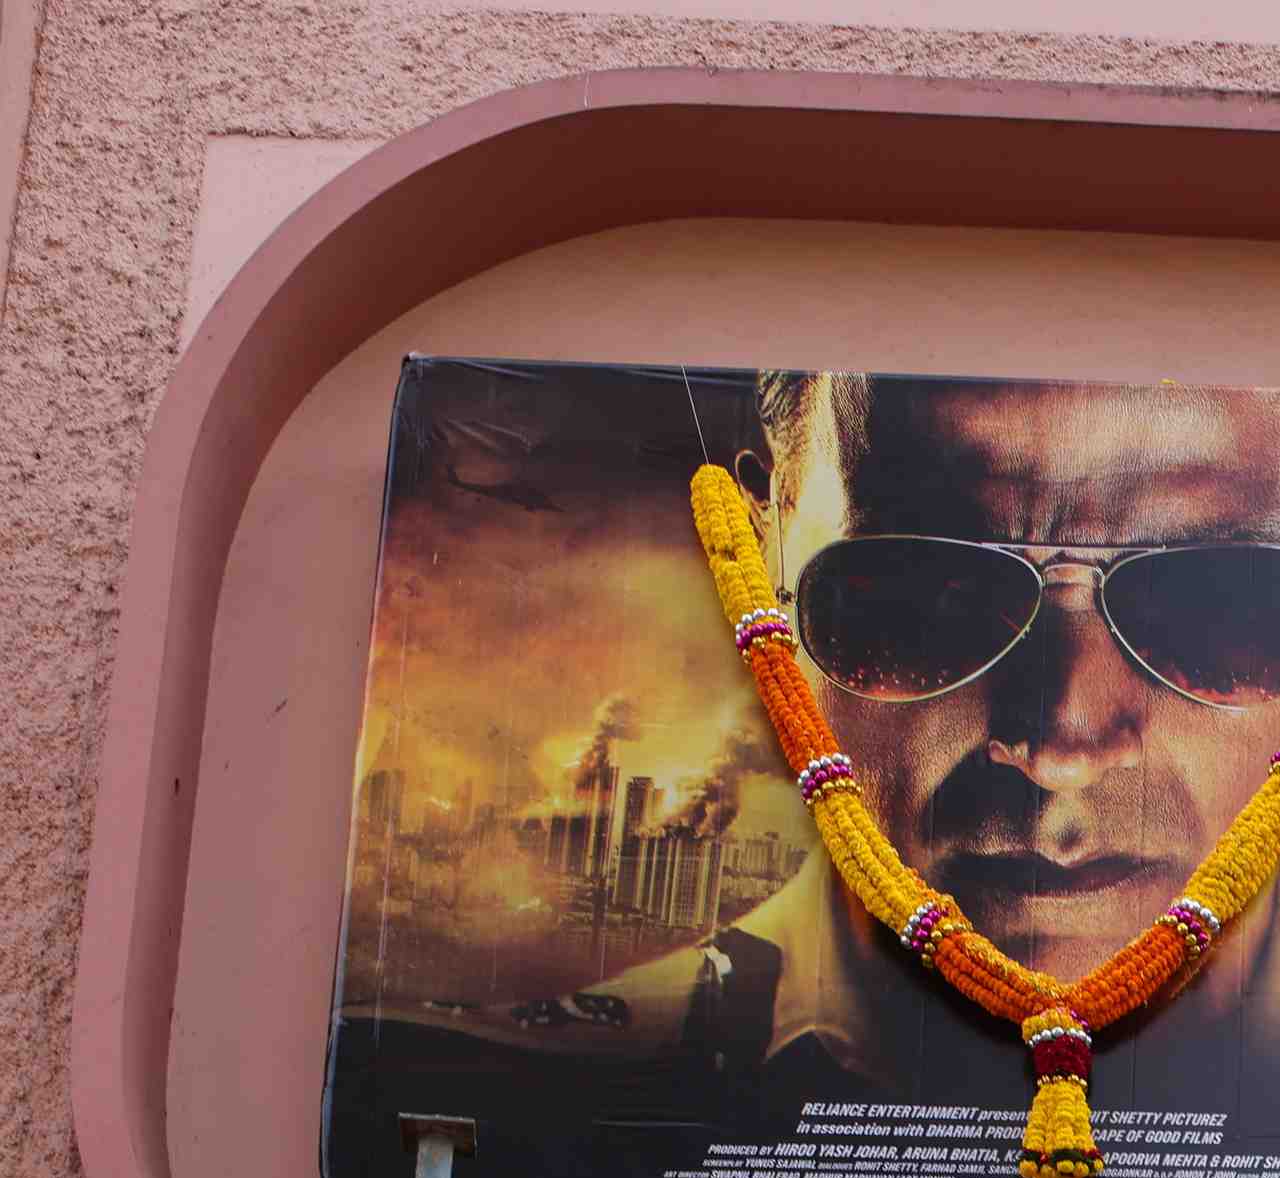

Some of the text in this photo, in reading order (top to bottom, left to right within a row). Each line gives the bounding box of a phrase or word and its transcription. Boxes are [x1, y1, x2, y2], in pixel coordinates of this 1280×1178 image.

[801, 1102, 867, 1118] RELIANCE
[867, 1104, 979, 1121] ENTERTAINMENT
[1110, 1111, 1163, 1125] SHETTY
[1162, 1112, 1228, 1127] PICTUREZ
[796, 1120, 809, 1134] in
[812, 1121, 892, 1136] association
[893, 1124, 924, 1137] with
[925, 1124, 983, 1139] DHARMA
[1125, 1130, 1145, 1143] OF
[1145, 1131, 1181, 1144] GOOD
[1181, 1131, 1224, 1145] FILMS
[707, 1144, 759, 1156] PRODUCED
[774, 1143, 817, 1157] HIROO
[818, 1144, 853, 1158] YASH
[853, 1145, 899, 1161] JOHAR,
[902, 1147, 949, 1161] ARUNA
[950, 1148, 1001, 1162] BHATIA,
[1103, 1152, 1162, 1166] APOORVA
[1162, 1153, 1208, 1168] MEHTA
[1210, 1155, 1221, 1168] &
[1221, 1155, 1264, 1169] ROHIT
[853, 1161, 883, 1172] ROHIT
